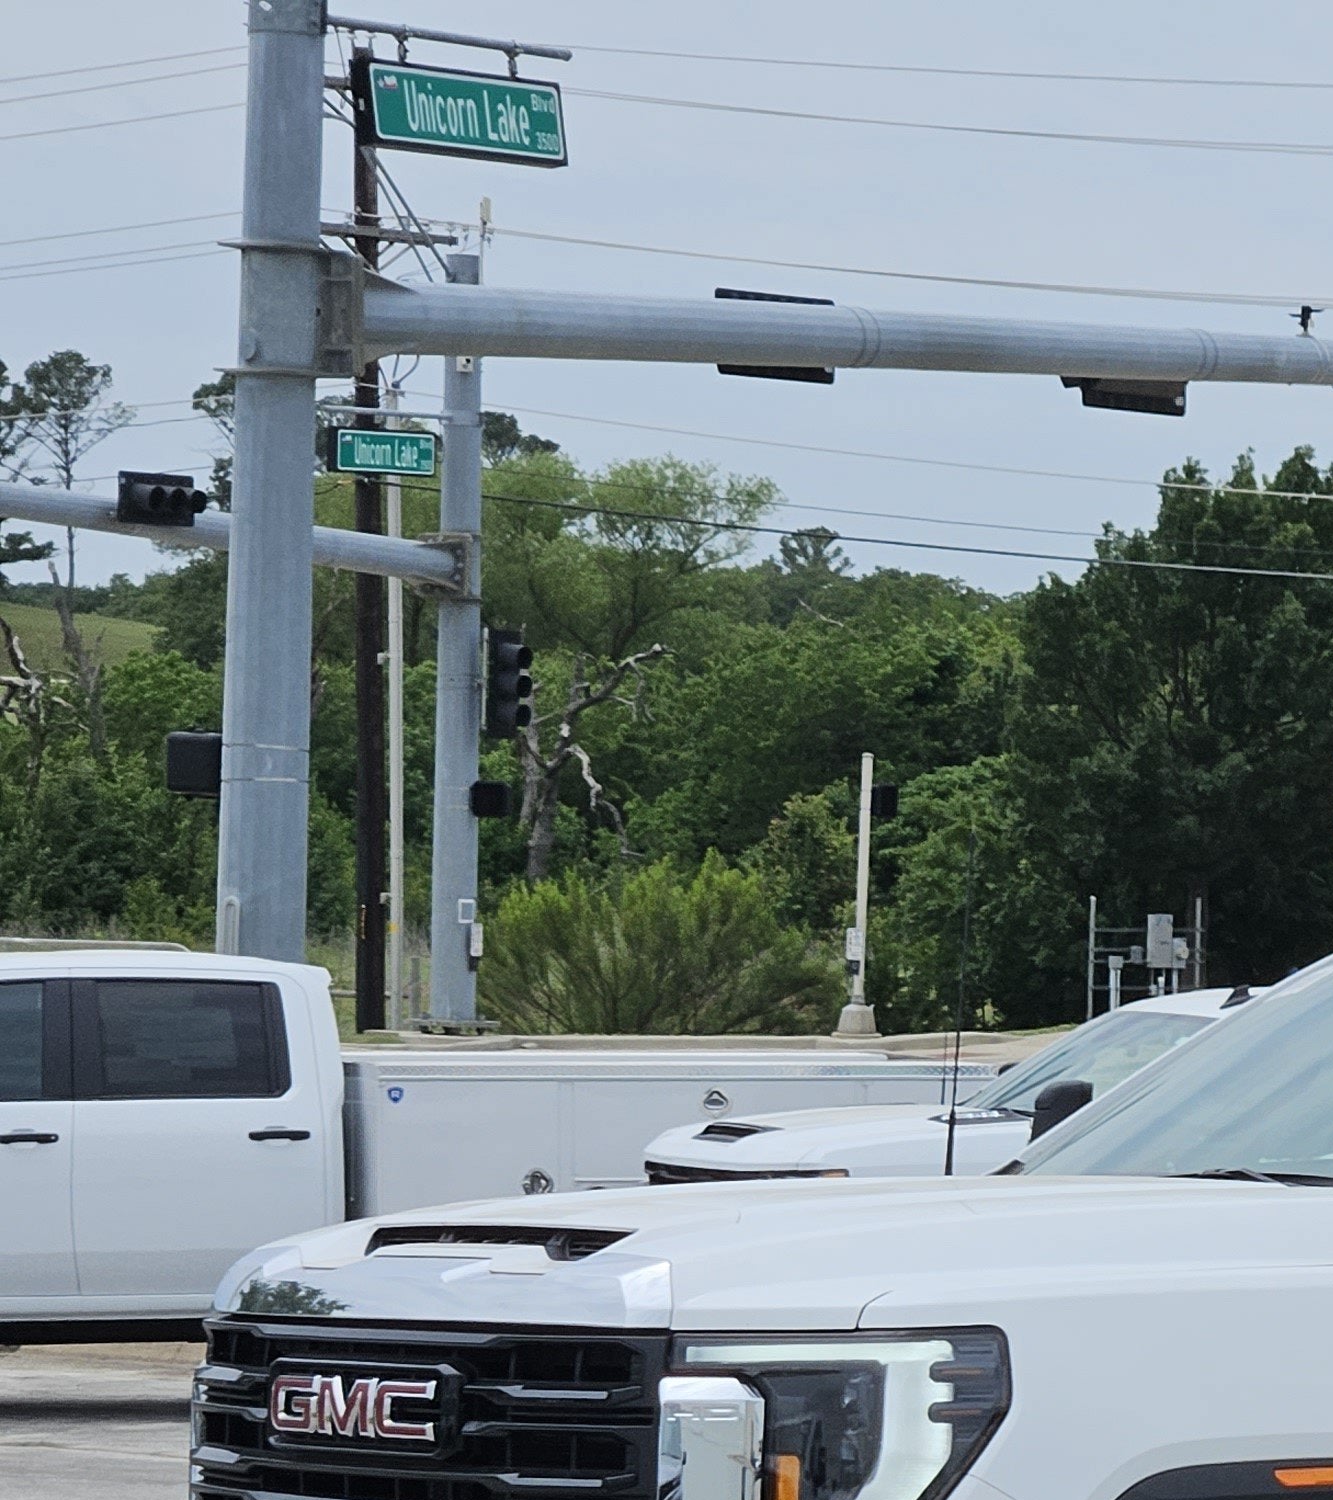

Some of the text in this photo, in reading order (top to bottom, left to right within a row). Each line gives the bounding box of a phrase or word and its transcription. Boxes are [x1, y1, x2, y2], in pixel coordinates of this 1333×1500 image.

[403, 79, 530, 146] Unicorn Lake
[530, 93, 556, 114] Blvd
[354, 436, 392, 466] Unicorn
[394, 438, 418, 467] Lake
[271, 1374, 437, 1441] GMC
